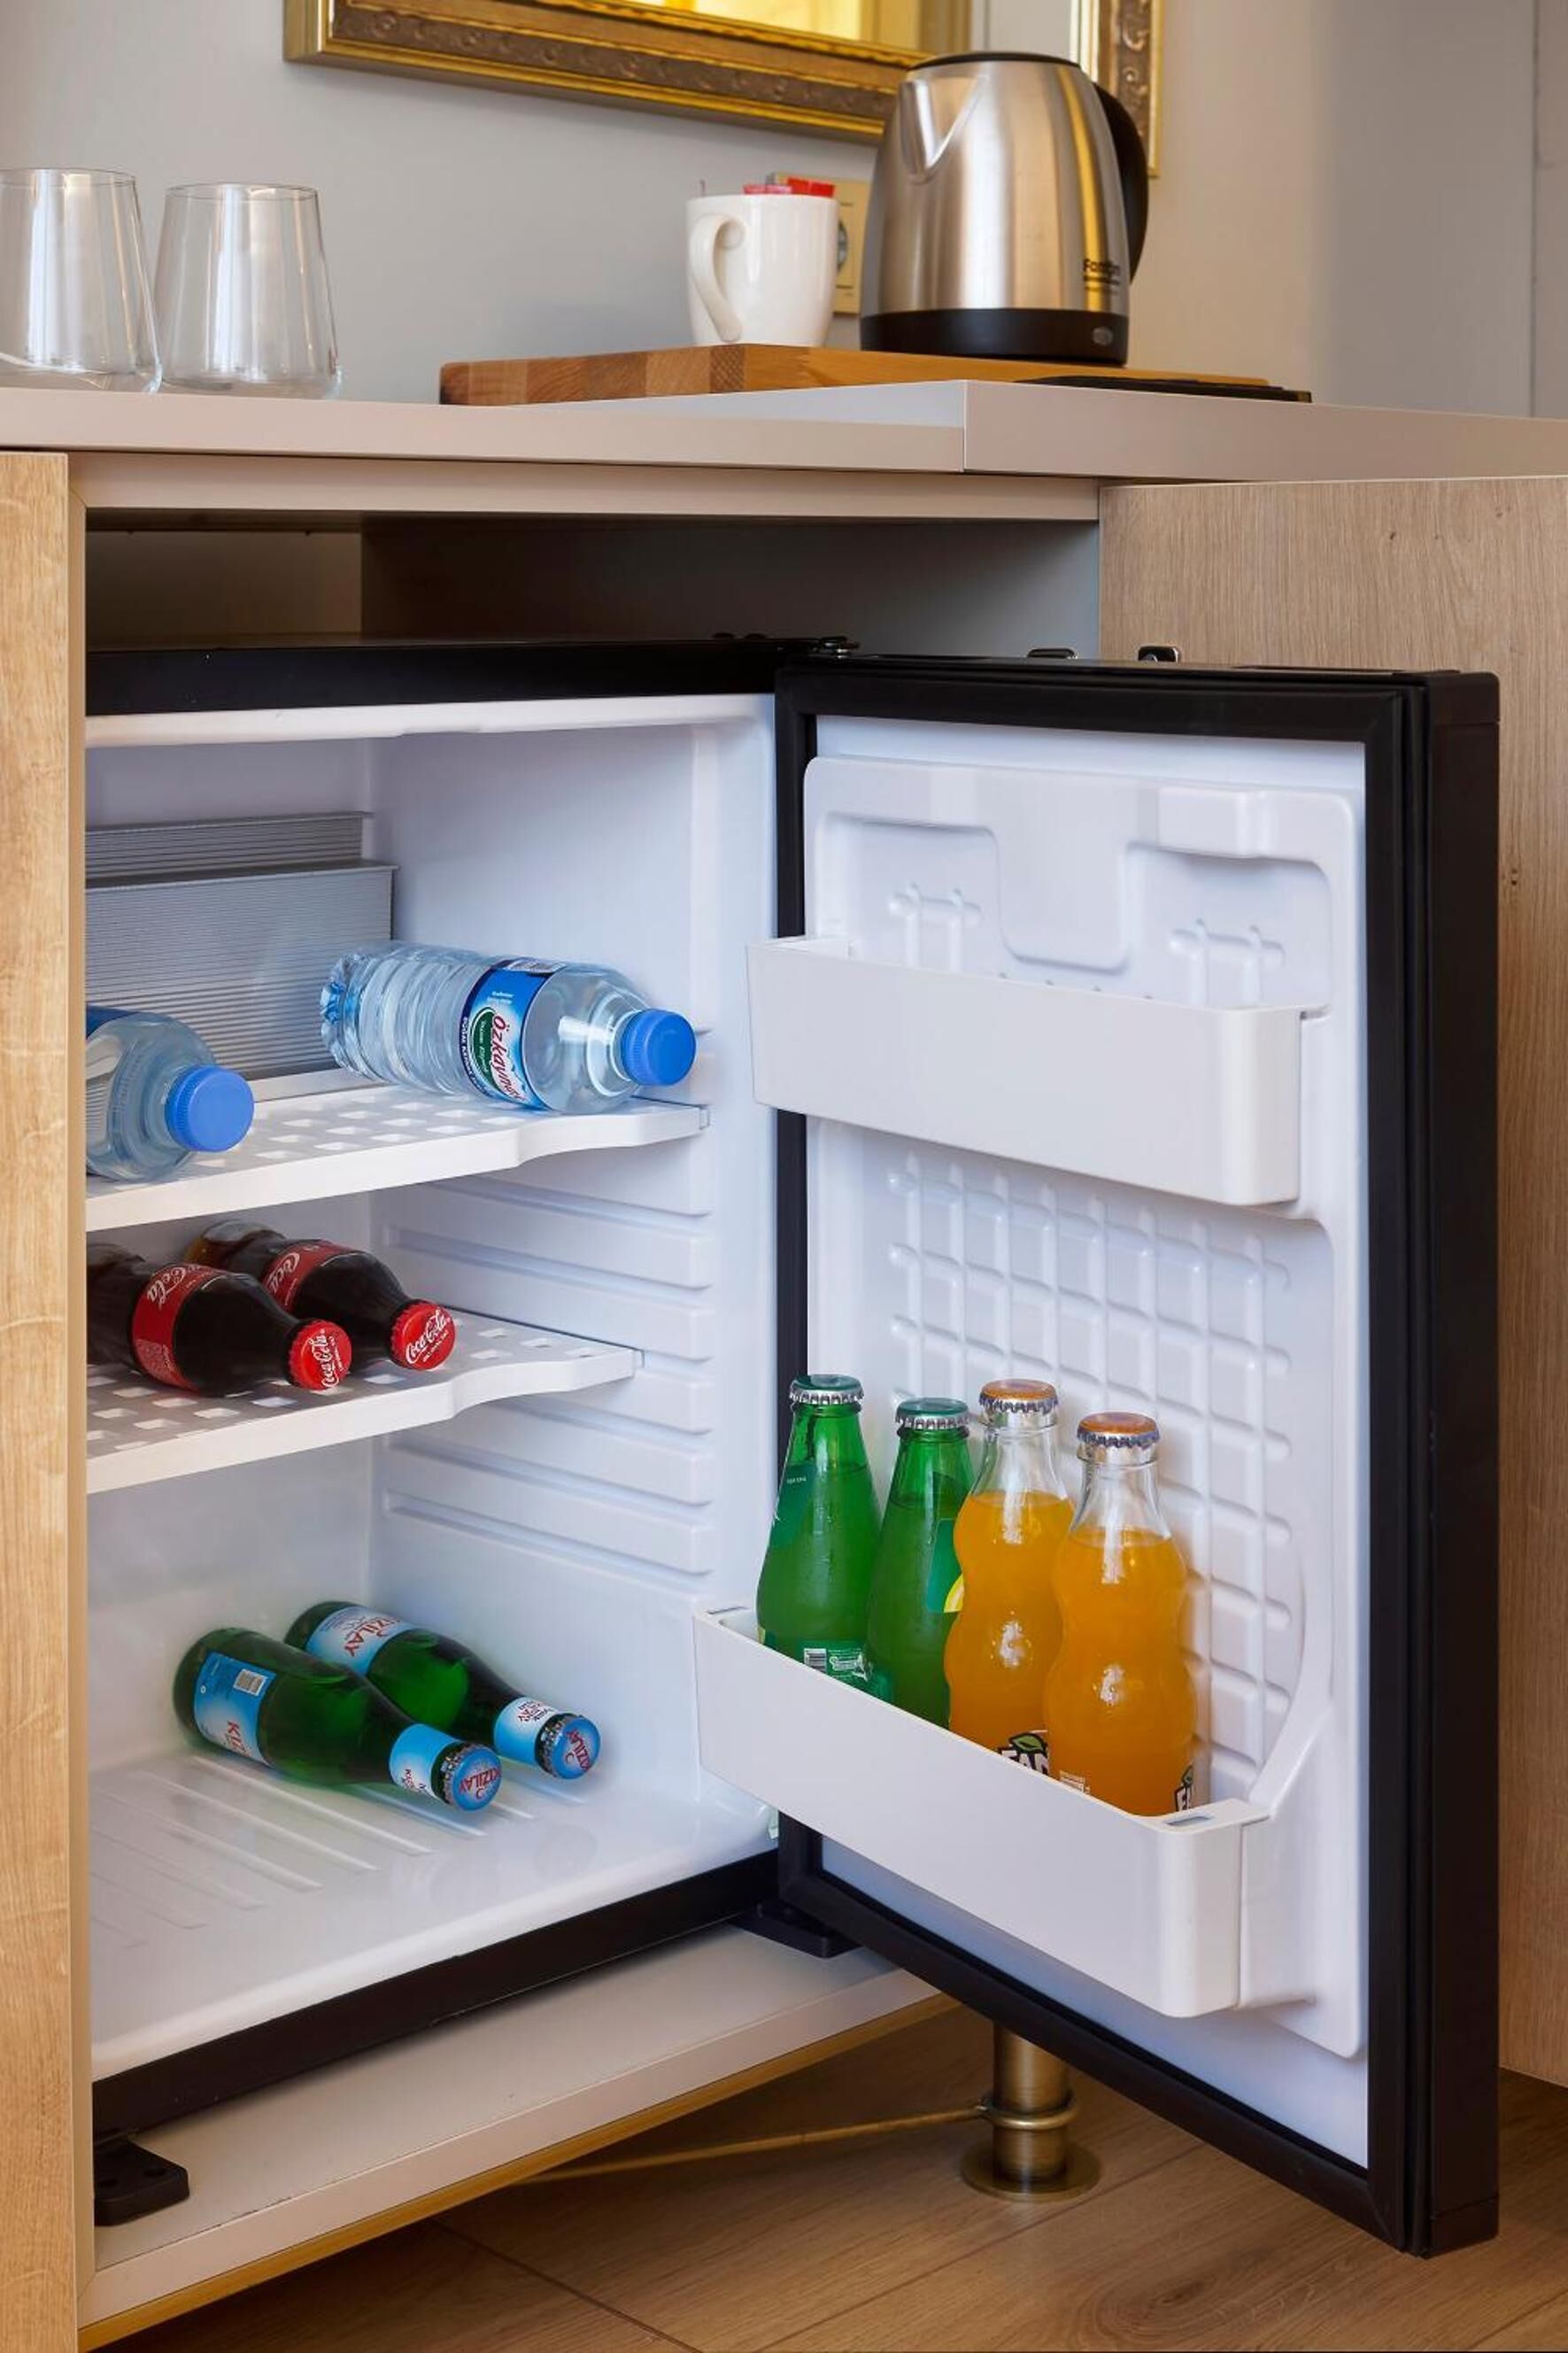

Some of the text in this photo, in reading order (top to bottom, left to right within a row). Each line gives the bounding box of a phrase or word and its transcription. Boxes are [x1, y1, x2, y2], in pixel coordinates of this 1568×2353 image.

[406, 1307, 447, 1364] Coca-Cola
[307, 1334, 339, 1388] Coca-Cola
[567, 1728, 591, 1772] KIZILAY
[459, 1767, 501, 1793] KIZILAY
